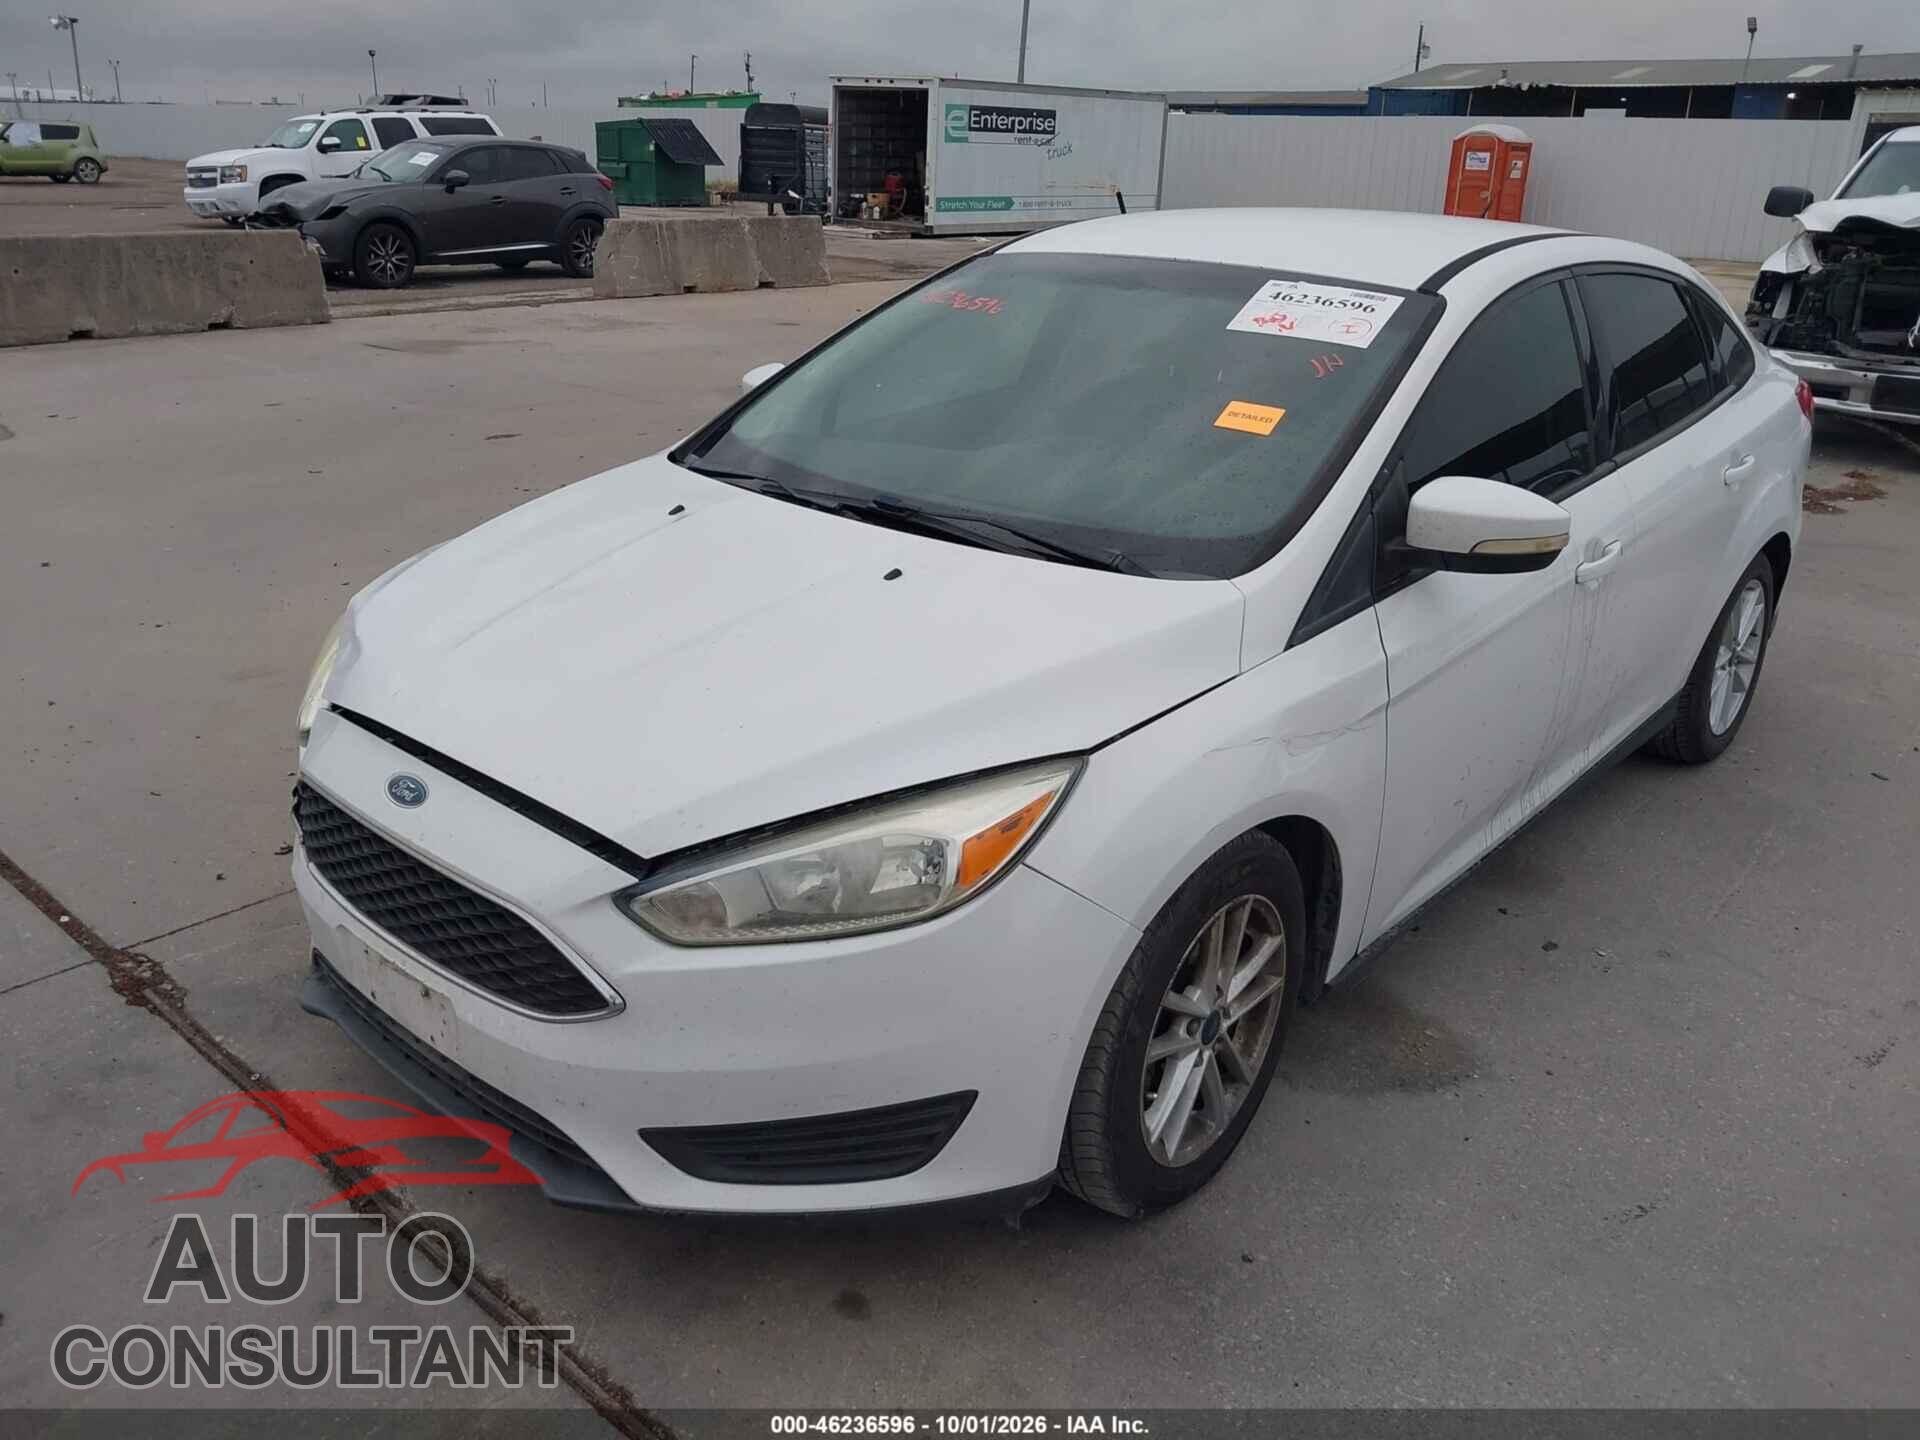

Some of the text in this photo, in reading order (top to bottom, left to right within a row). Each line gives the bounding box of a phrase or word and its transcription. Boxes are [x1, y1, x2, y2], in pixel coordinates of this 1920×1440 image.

[970, 110, 1055, 133] Enterprise
[1047, 142, 1073, 160] truck
[968, 200, 985, 209] Your
[986, 200, 1006, 209] Fleet
[1268, 290, 1376, 314] 46236596
[1227, 411, 1273, 424] DETAILED
